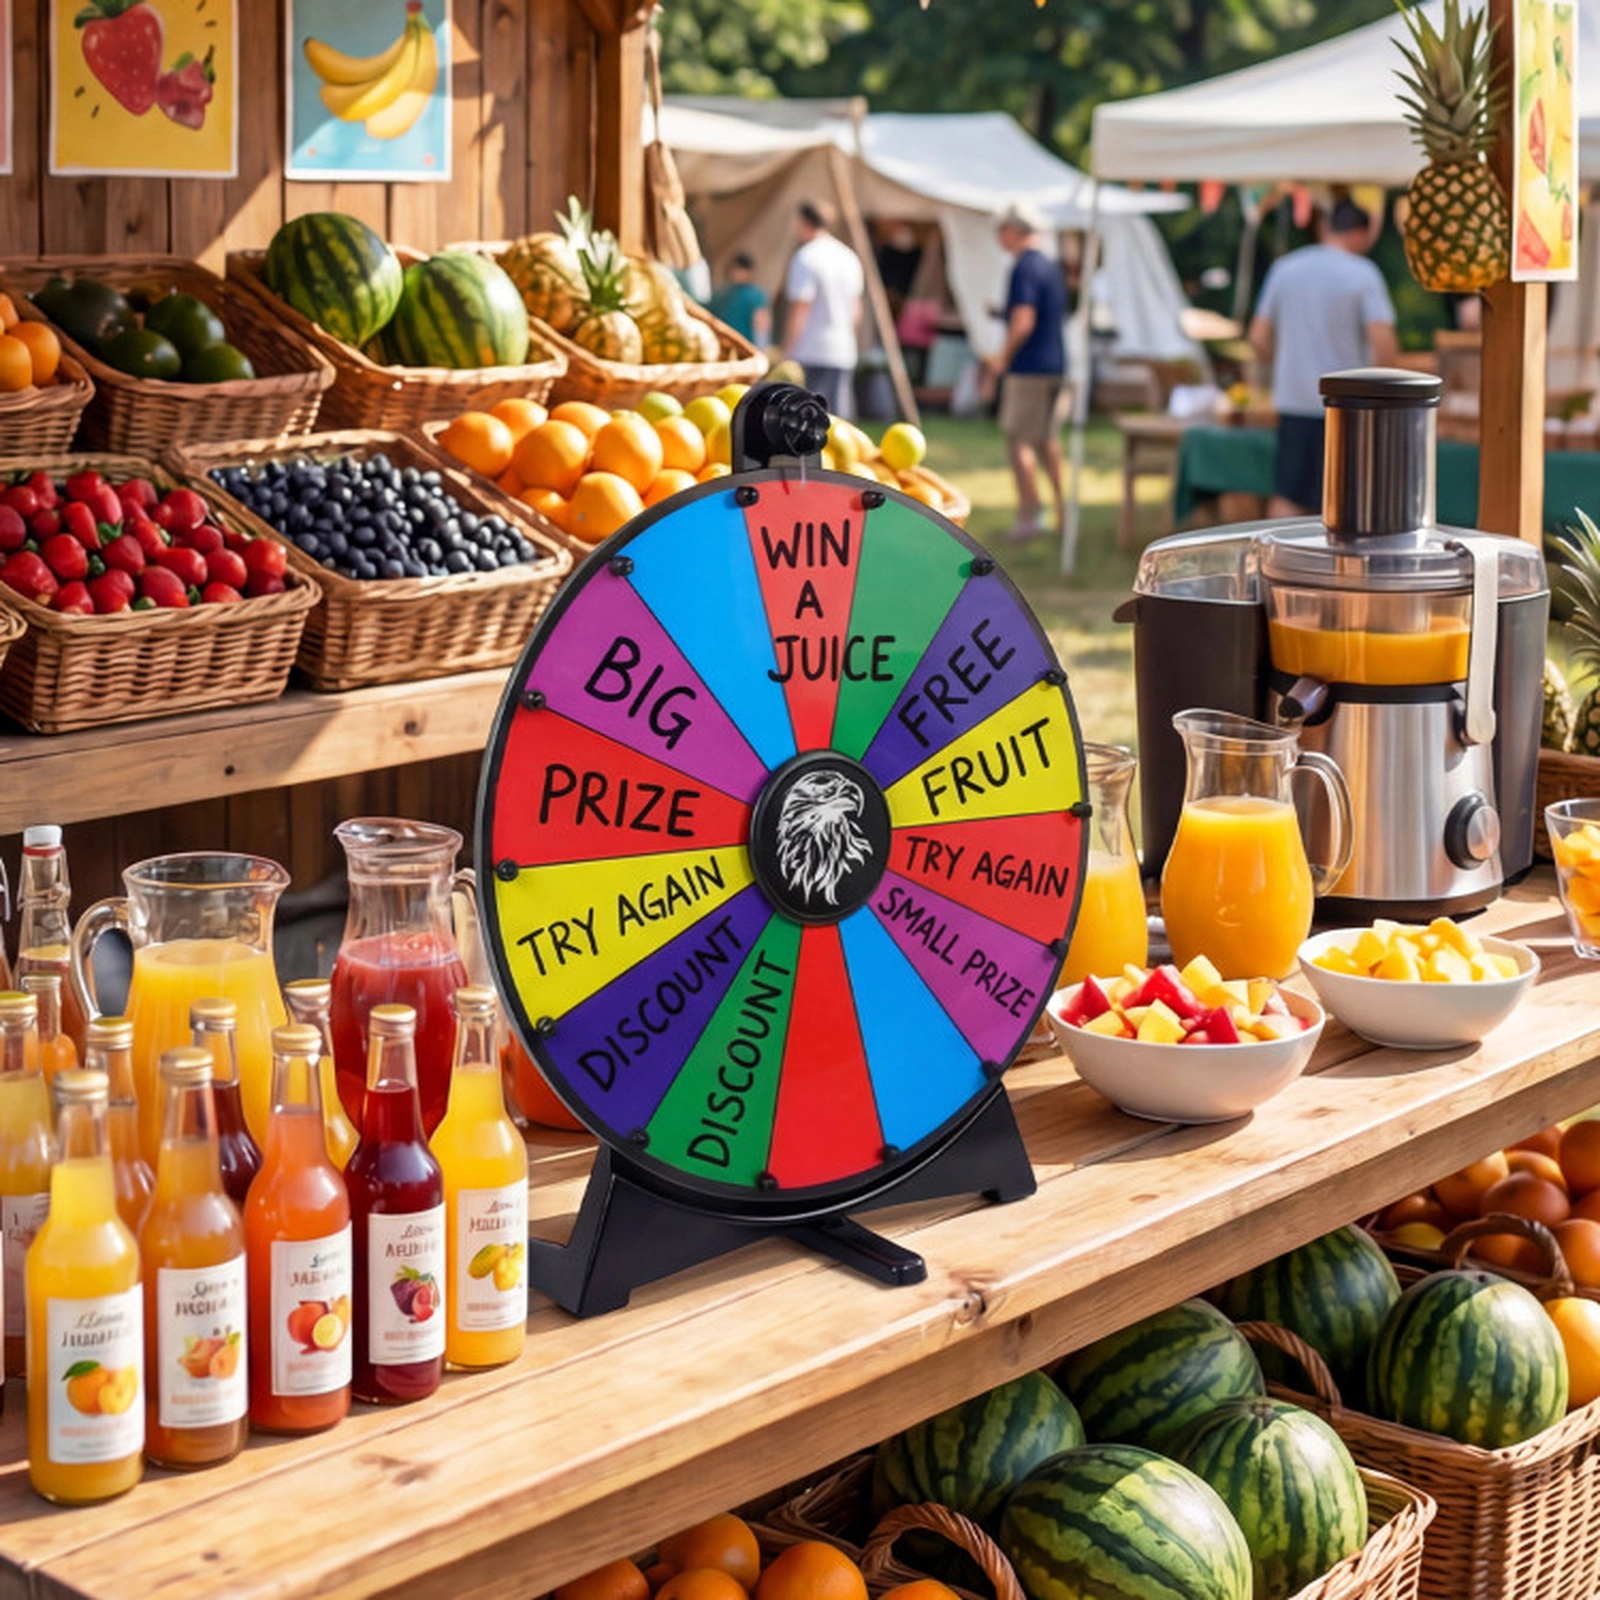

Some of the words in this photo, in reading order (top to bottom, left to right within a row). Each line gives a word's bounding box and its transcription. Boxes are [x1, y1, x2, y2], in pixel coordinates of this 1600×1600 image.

[762, 520, 849, 568] WIN
[795, 581, 823, 618] A
[584, 637, 697, 750] BIG
[767, 636, 895, 684] JUICE
[898, 619, 1015, 748] FREE
[540, 764, 700, 836] PRIZE
[922, 718, 1050, 815] FRUIT
[518, 909, 597, 975] TRY
[619, 856, 725, 935] AGAIN
[906, 837, 963, 878] TRY
[973, 853, 1069, 897] AGAIN
[577, 916, 743, 1092] DISCOUNT
[878, 888, 958, 964] SMALL
[962, 950, 1034, 1017] PRIZE
[686, 950, 790, 1168] DISCOUNT
